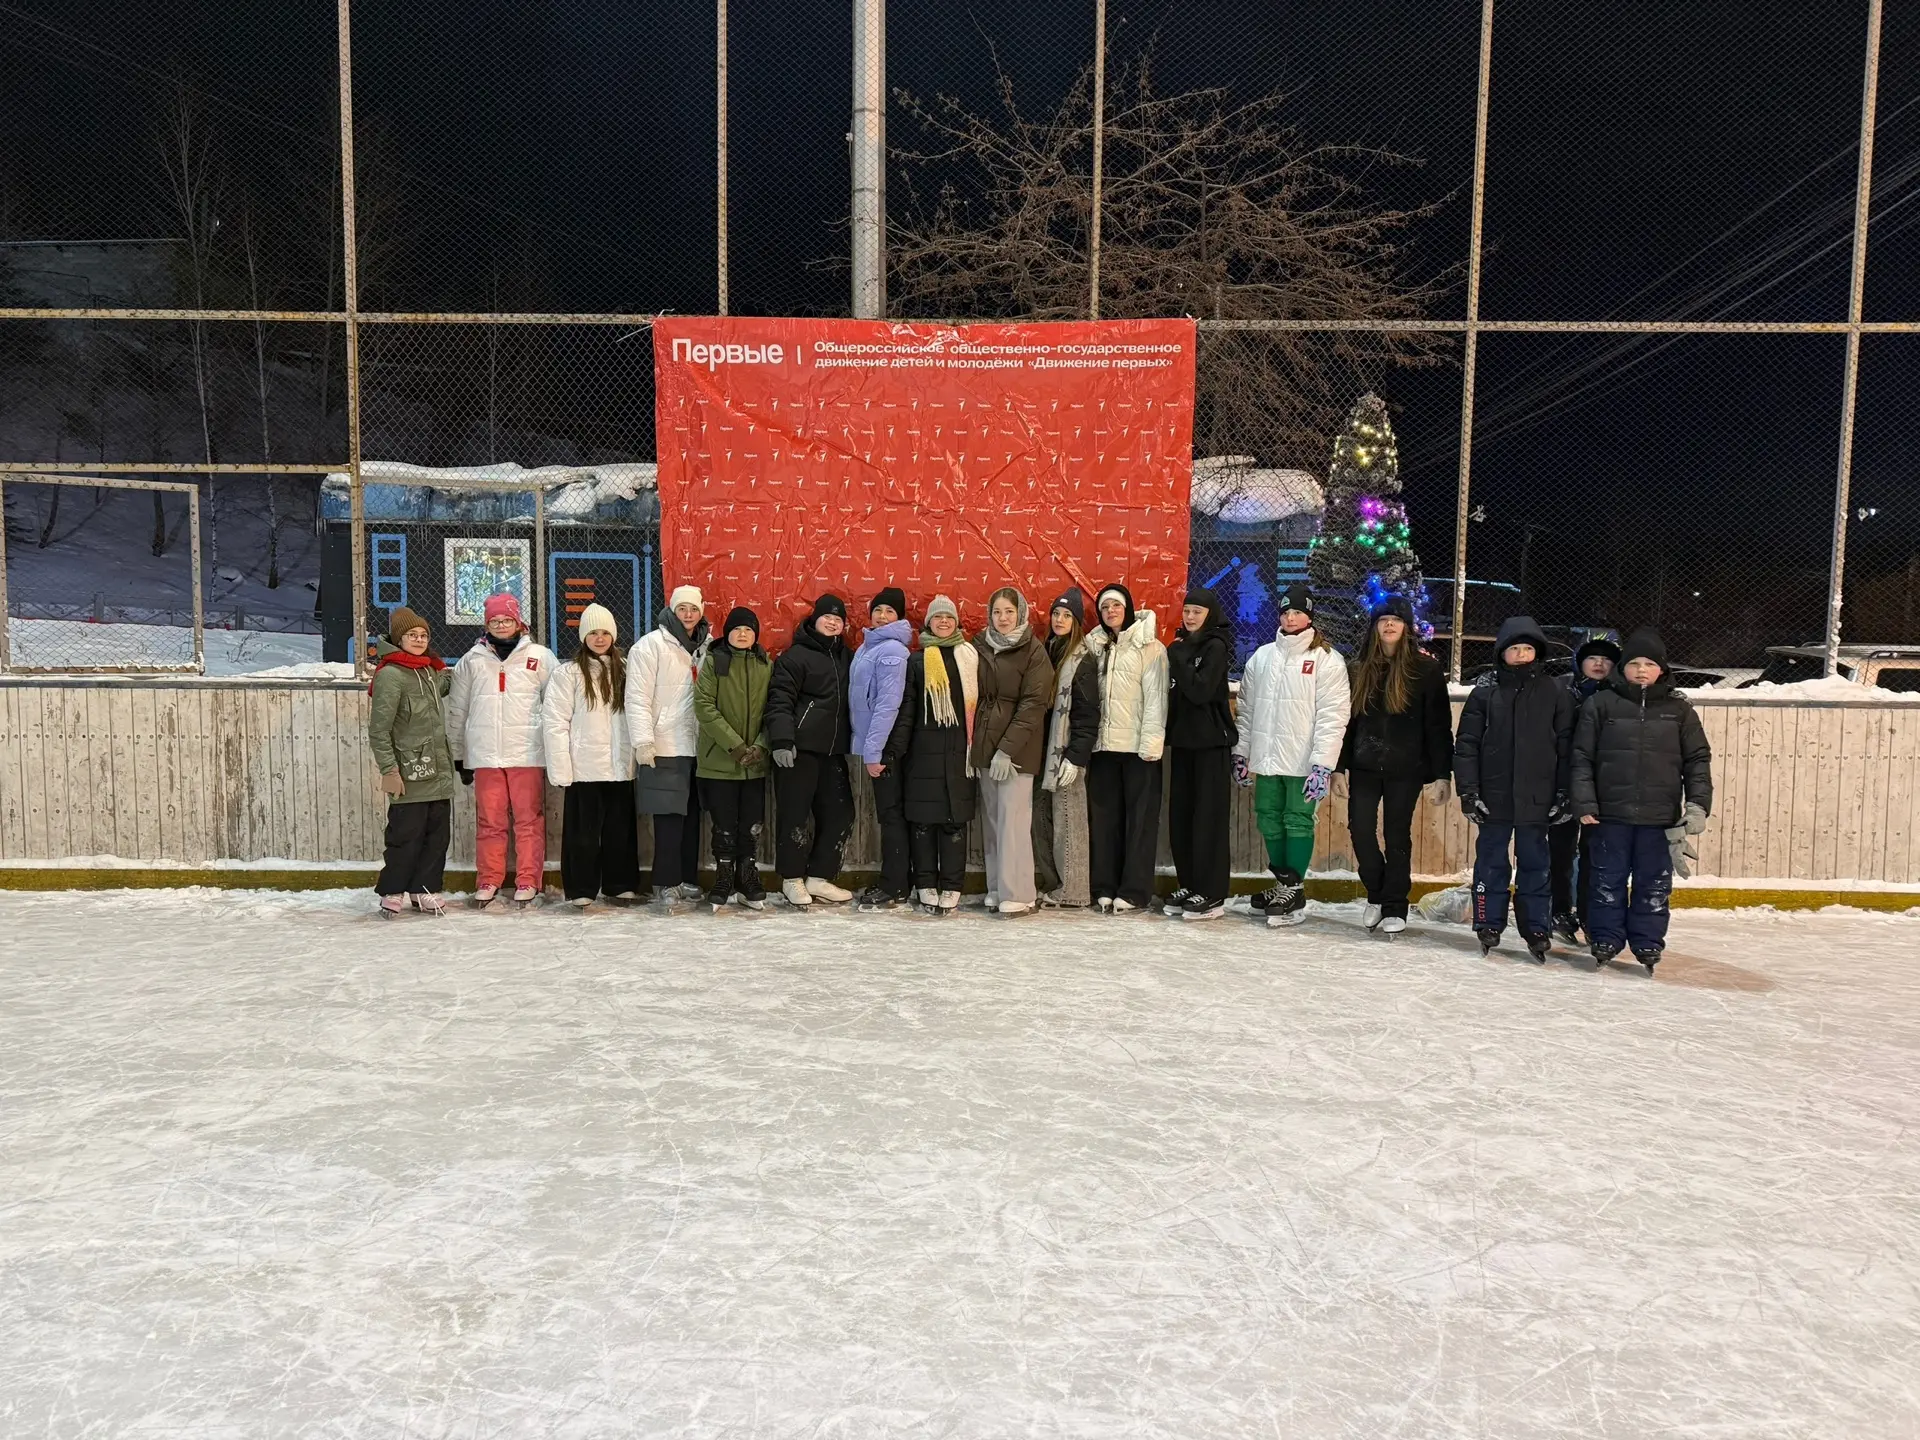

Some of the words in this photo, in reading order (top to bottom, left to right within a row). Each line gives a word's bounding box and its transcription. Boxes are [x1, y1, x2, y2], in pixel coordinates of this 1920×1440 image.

[671, 338, 784, 372] Первые
[814, 341, 945, 355] Общероссийское
[949, 342, 1182, 356] общественно-государственное
[815, 357, 888, 369] движение
[890, 356, 934, 368] детей
[935, 358, 945, 367] и
[947, 357, 1024, 370] молодёжи
[1027, 357, 1110, 369] «Движение
[1112, 357, 1173, 369] первых»
[419, 768, 435, 777] CAN
